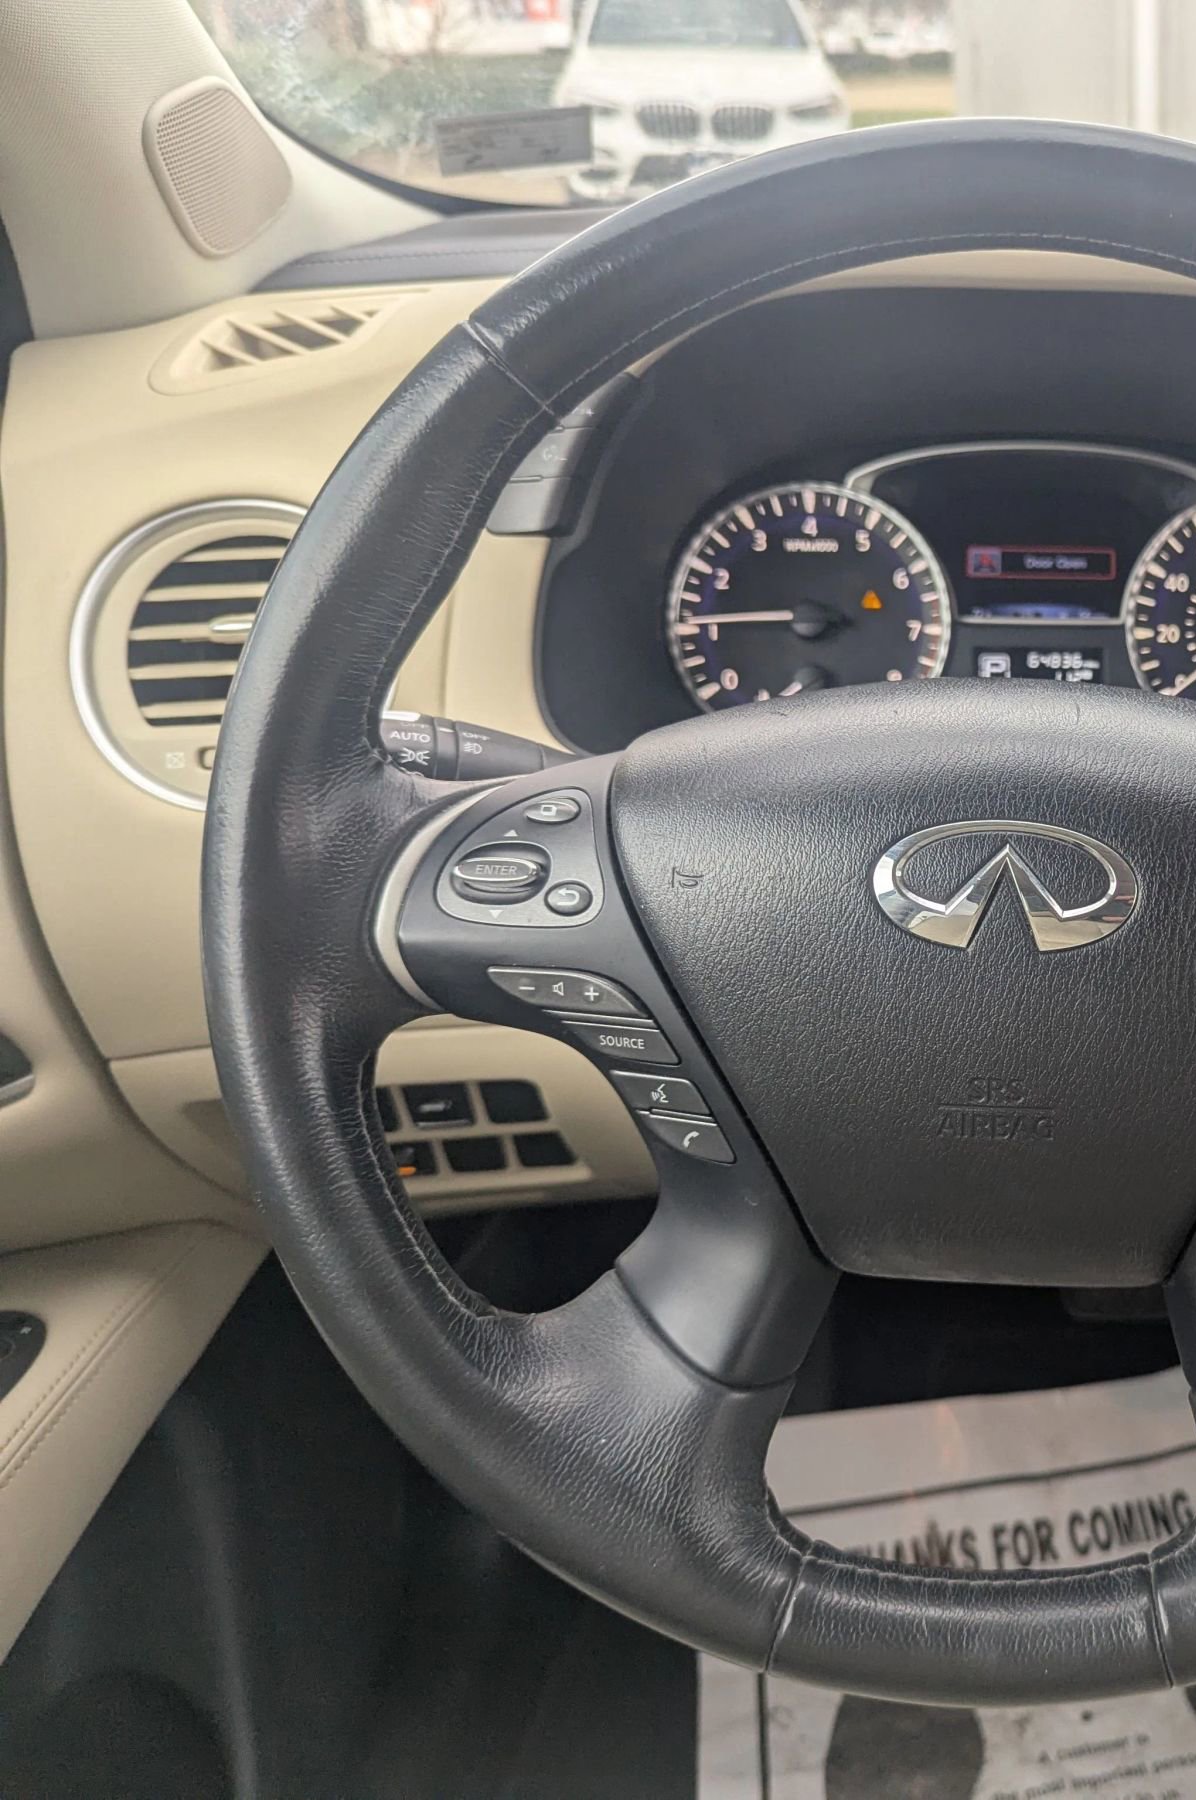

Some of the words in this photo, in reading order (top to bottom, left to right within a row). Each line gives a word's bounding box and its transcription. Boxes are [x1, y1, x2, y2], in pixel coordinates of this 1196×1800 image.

[802, 515, 818, 537] 4
[751, 529, 767, 552] 3
[856, 529, 871, 552] 5
[714, 568, 730, 590] 2
[893, 567, 909, 590] 6
[1164, 573, 1190, 593] 40
[906, 619, 922, 641] 7
[1157, 624, 1181, 643] 20
[720, 668, 739, 690] 0
[390, 730, 431, 743] AUTO
[475, 864, 517, 876] ENTER
[599, 1034, 645, 1049] SOURCE
[990, 1516, 1058, 1570] FOR
[1067, 1489, 1196, 1556] COMING
